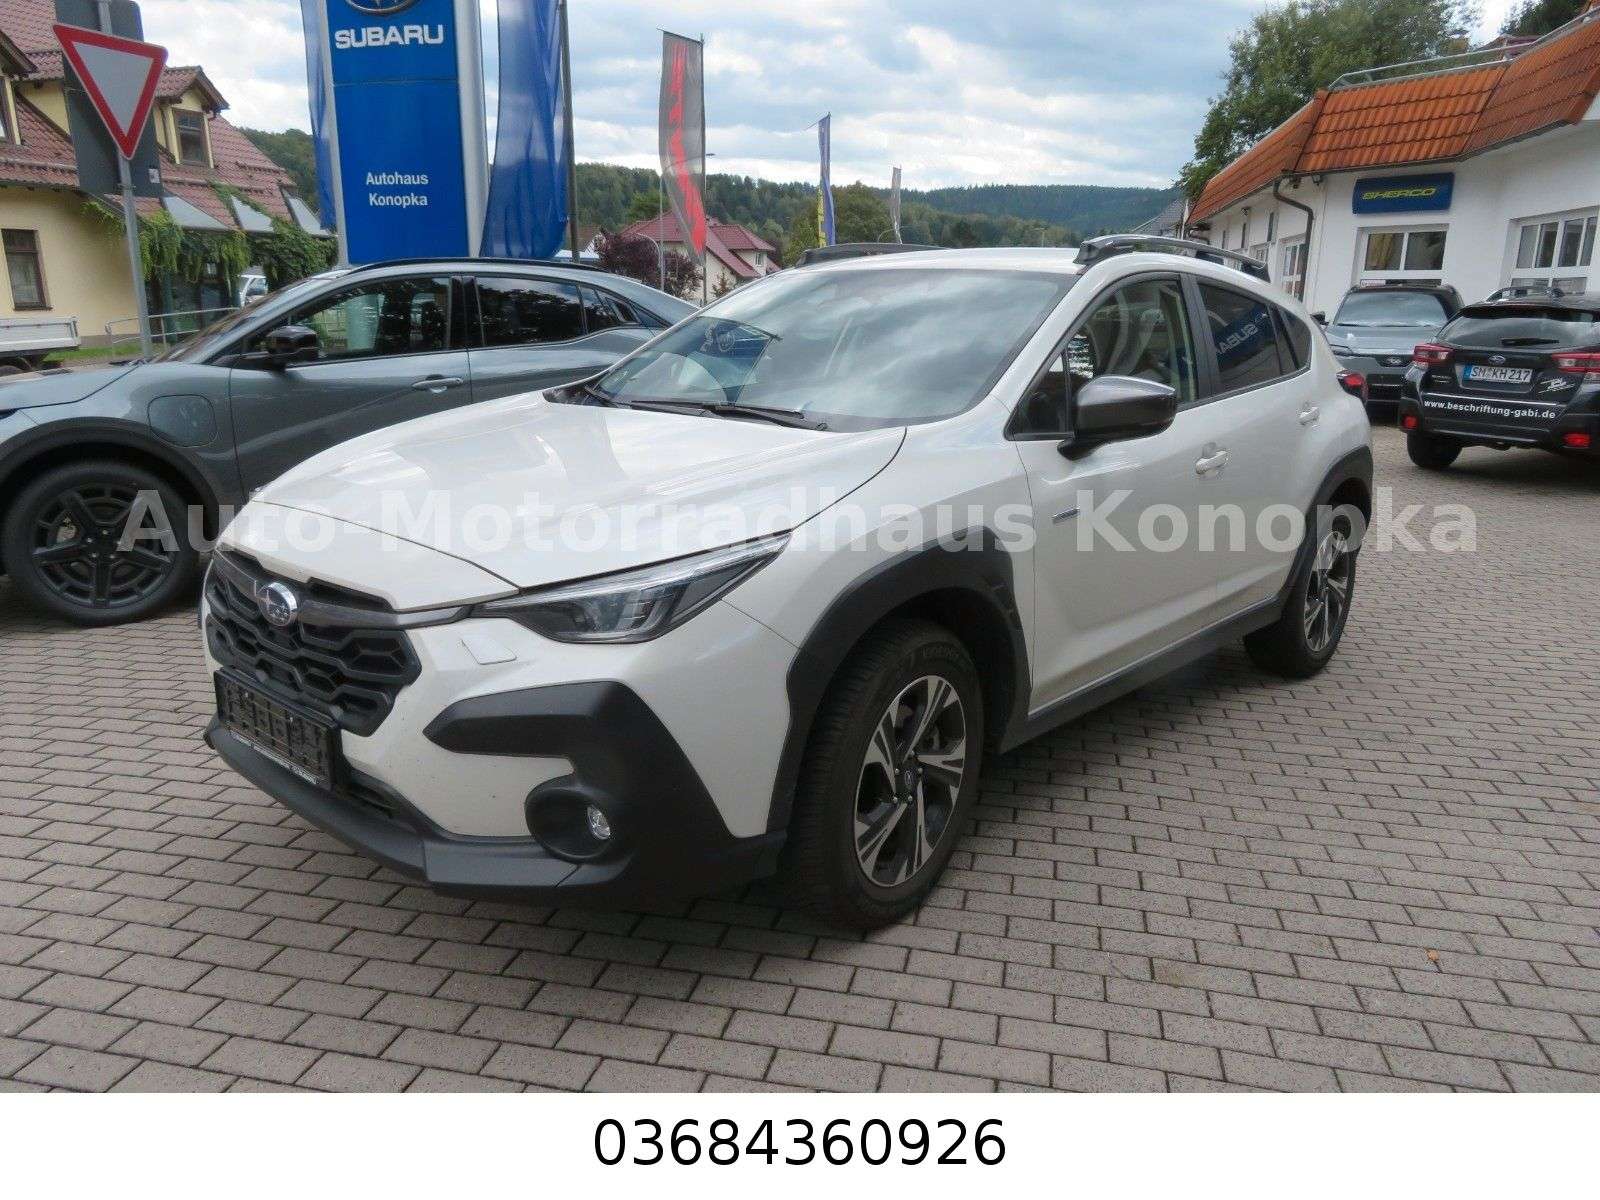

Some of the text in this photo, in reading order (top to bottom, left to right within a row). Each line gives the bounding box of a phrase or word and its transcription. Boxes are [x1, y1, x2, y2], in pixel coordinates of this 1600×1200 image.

[335, 24, 444, 49] SUBARU
[366, 171, 429, 186] Autohaus
[368, 192, 429, 209] Konopka
[1423, 400, 1556, 419] www.beschriftung-gabi.de
